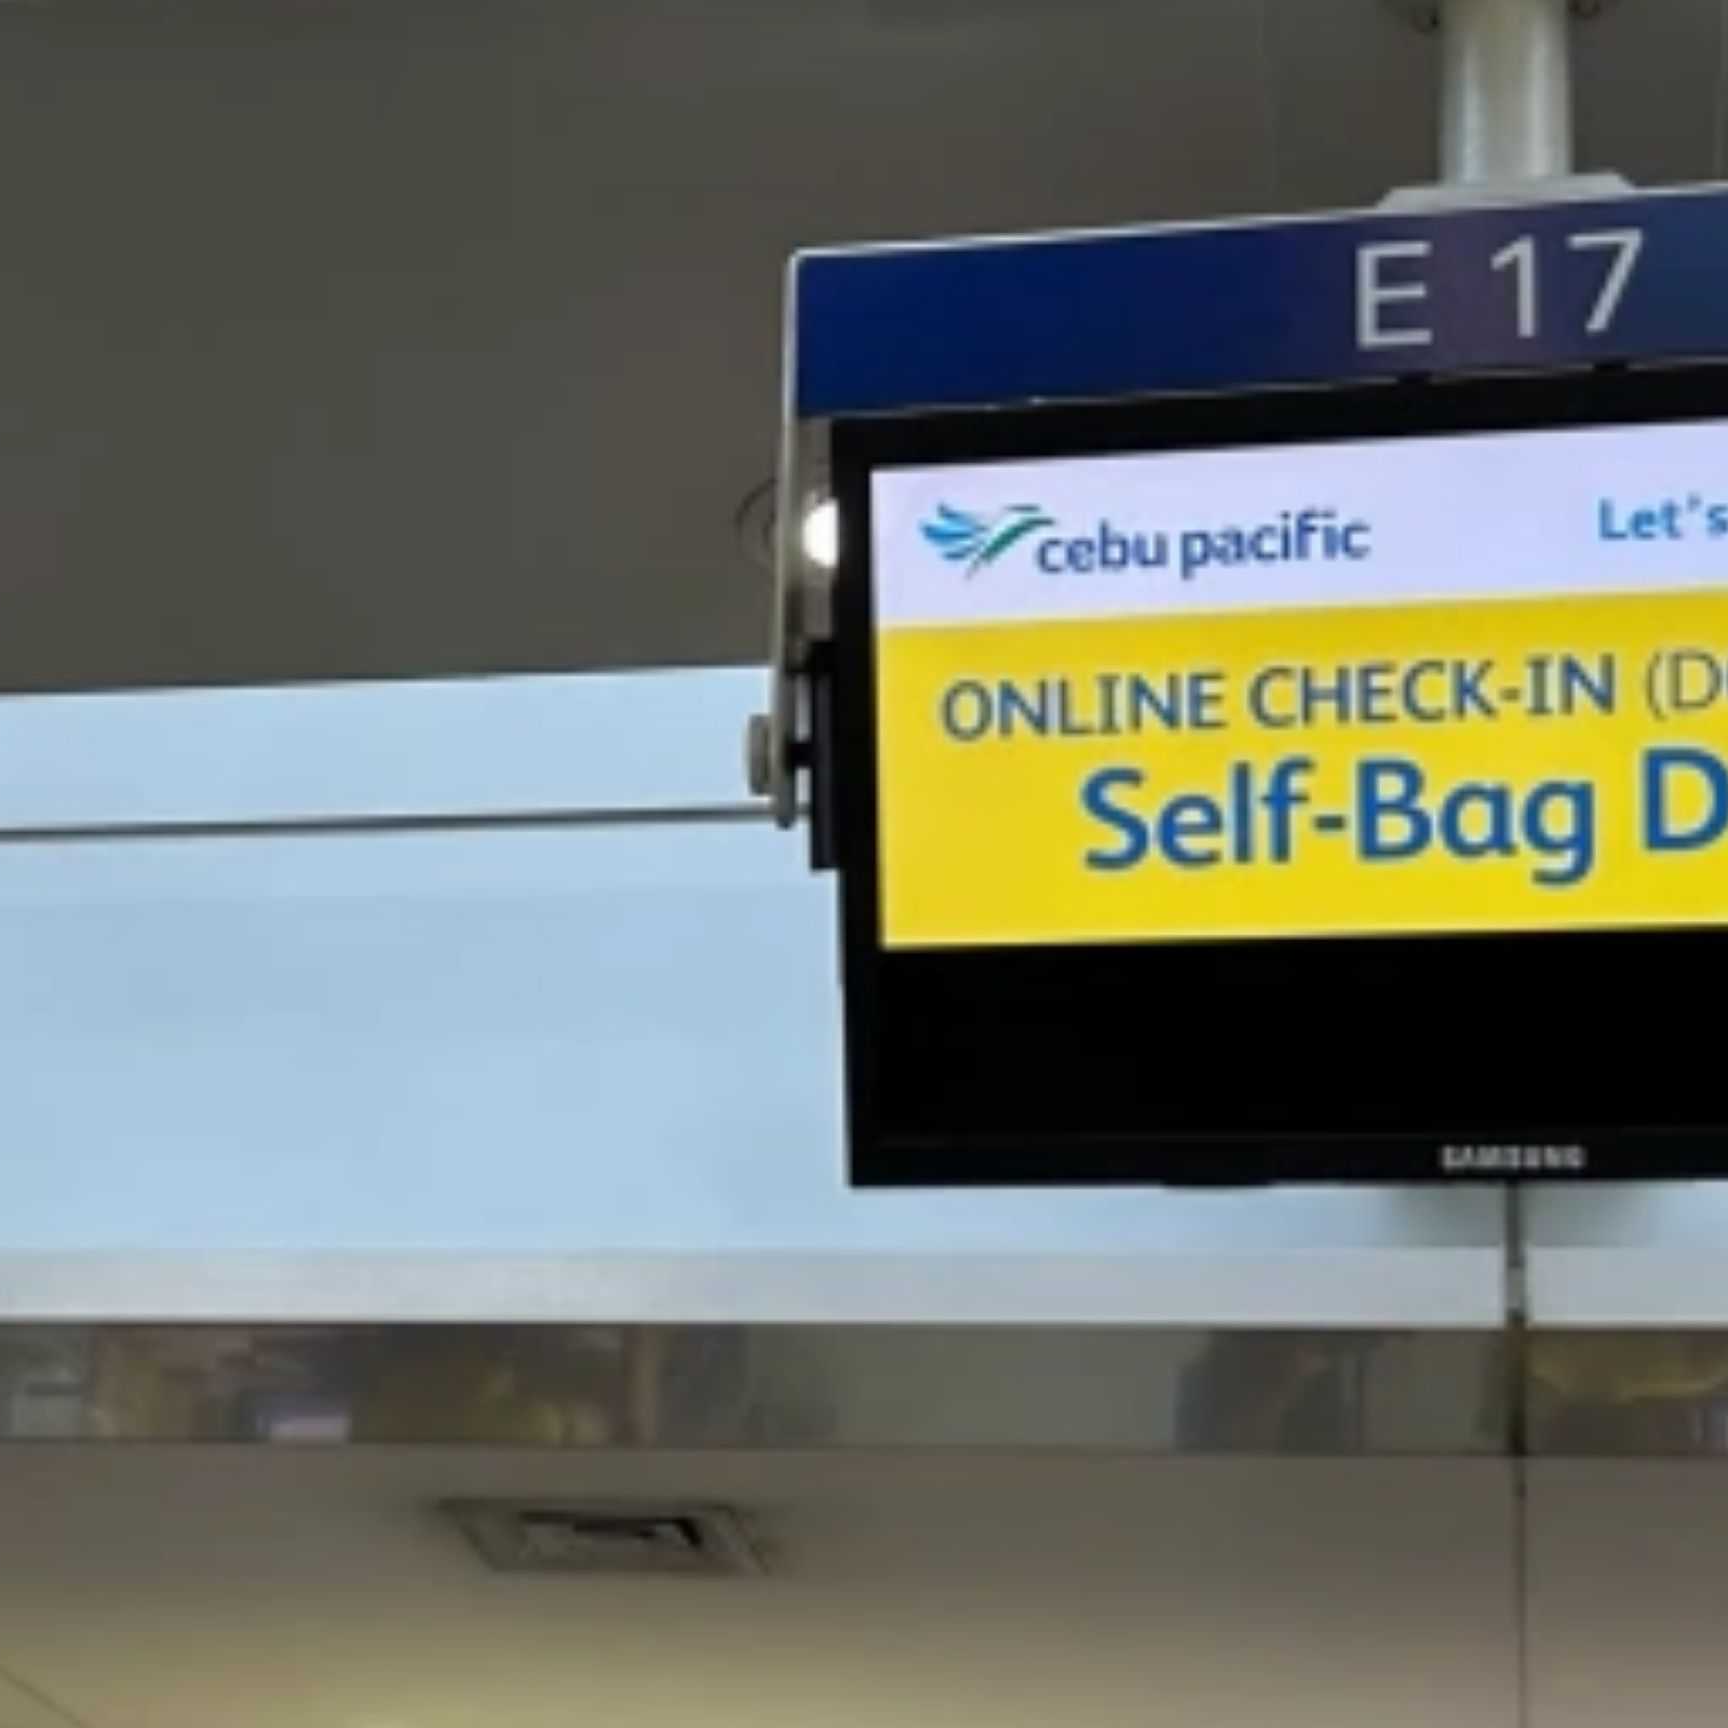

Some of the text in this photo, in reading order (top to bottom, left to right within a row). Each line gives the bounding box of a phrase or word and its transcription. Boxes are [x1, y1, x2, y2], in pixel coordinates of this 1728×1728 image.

[1356, 227, 1643, 349] E 17
[1033, 508, 1370, 582] cebu pacific
[942, 672, 1227, 742] ONLINE
[1247, 652, 1617, 733] CHECK-IN
[1079, 754, 1597, 886] Self-Bag
